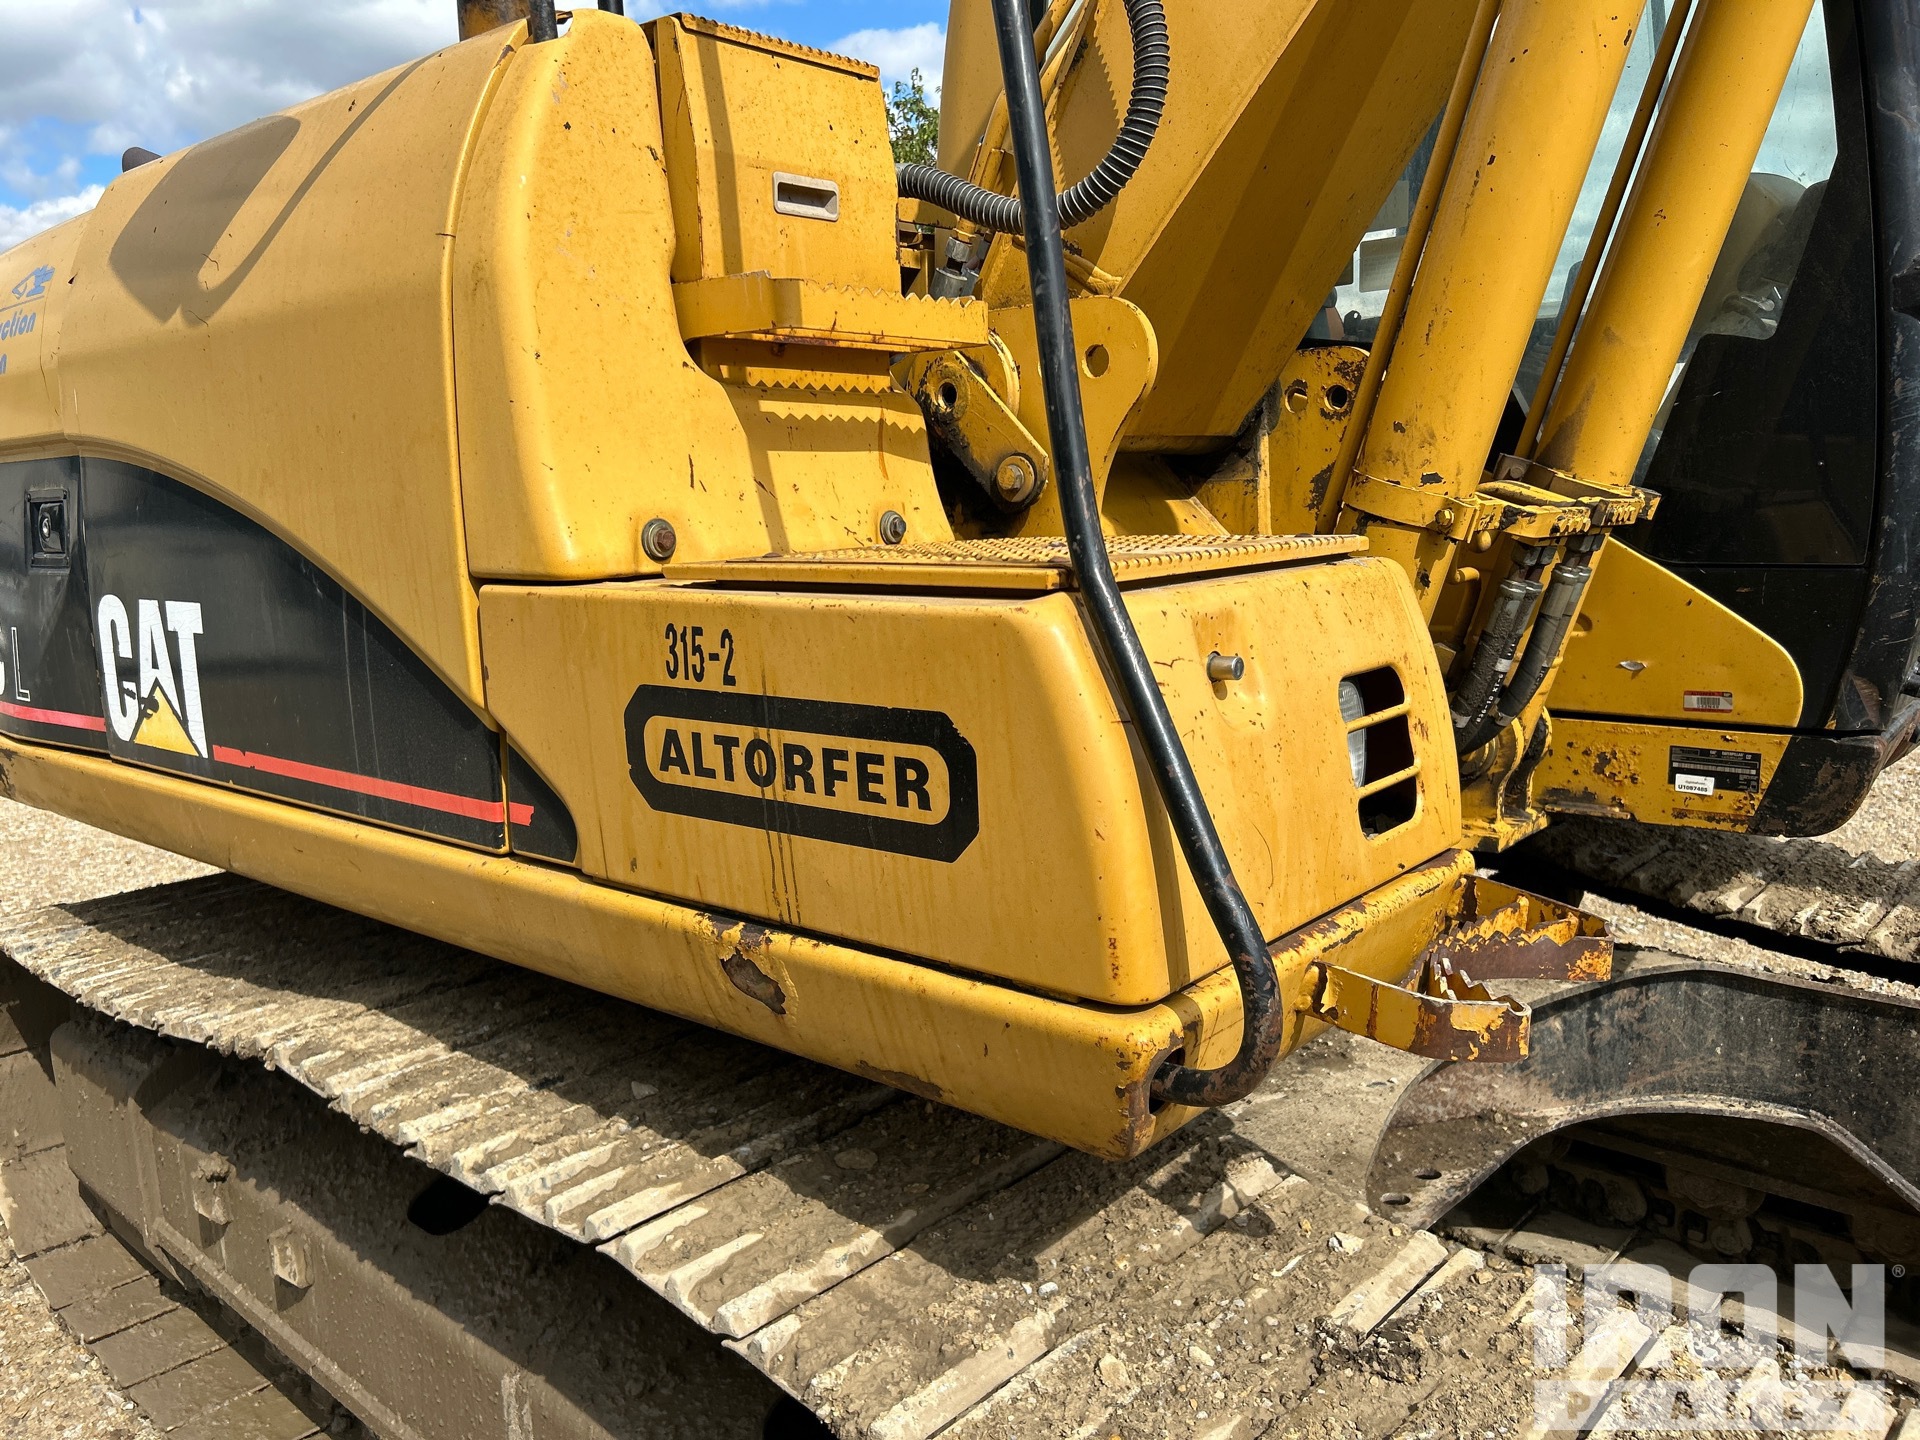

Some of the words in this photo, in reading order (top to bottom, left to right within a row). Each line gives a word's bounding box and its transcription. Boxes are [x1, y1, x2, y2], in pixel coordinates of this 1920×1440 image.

[97, 593, 208, 759] CAT
[664, 622, 737, 687] 315-2
[658, 728, 932, 812] ALTORFER
